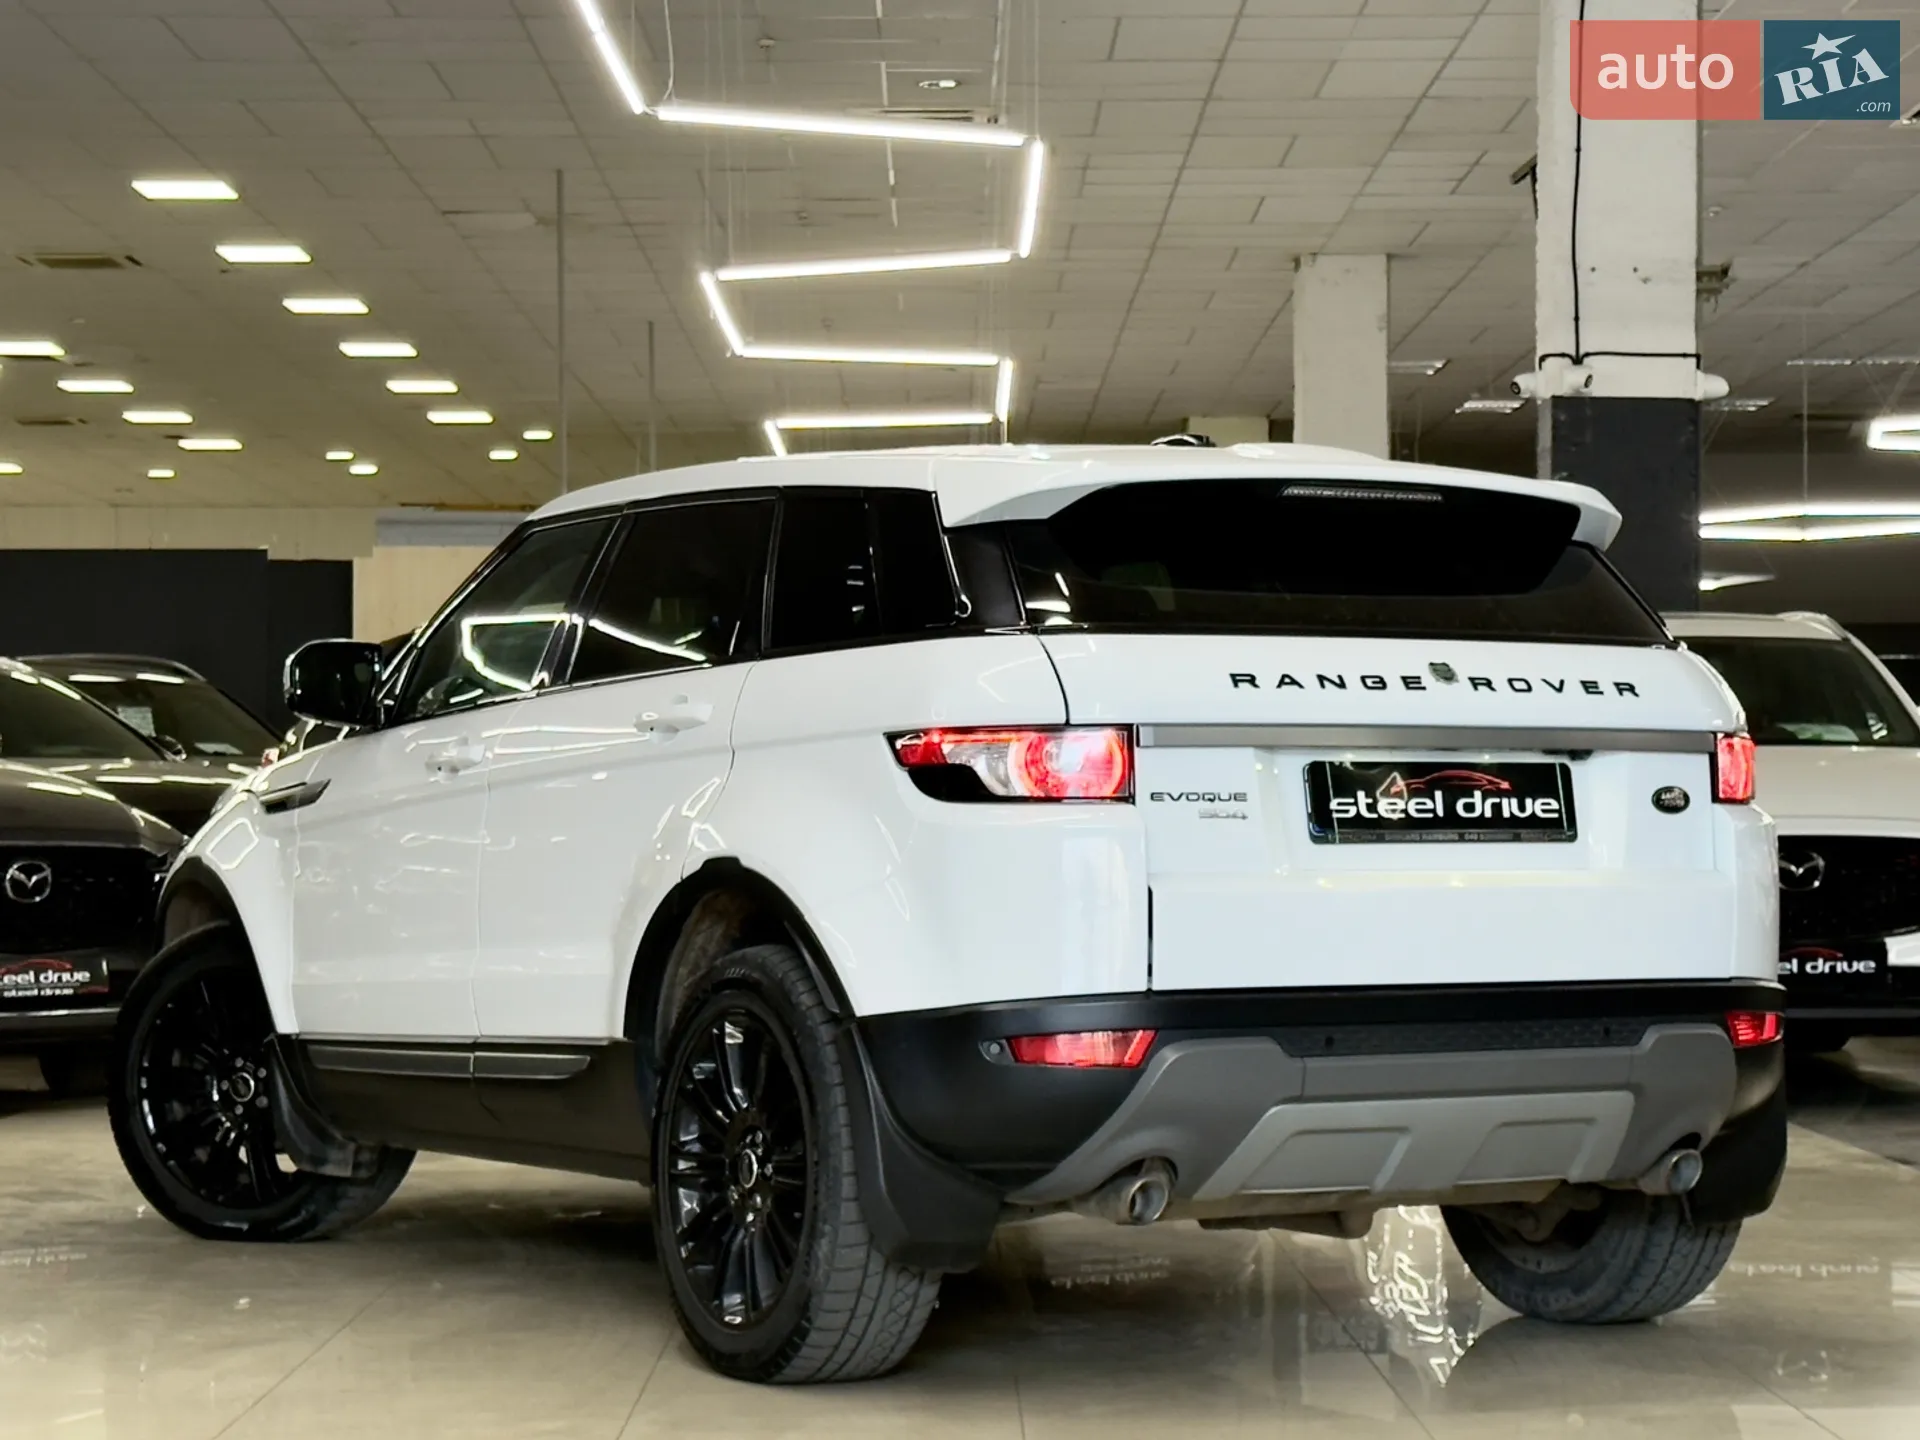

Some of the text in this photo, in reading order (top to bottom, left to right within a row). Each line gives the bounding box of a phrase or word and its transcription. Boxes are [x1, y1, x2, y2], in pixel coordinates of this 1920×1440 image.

[1229, 673, 1640, 697] RANGE ROVER
[1150, 792, 1248, 803] EVOQUE
[1329, 790, 1560, 819] steel drive
[1804, 957, 1877, 975] drive
[0, 969, 91, 986] eel drive
